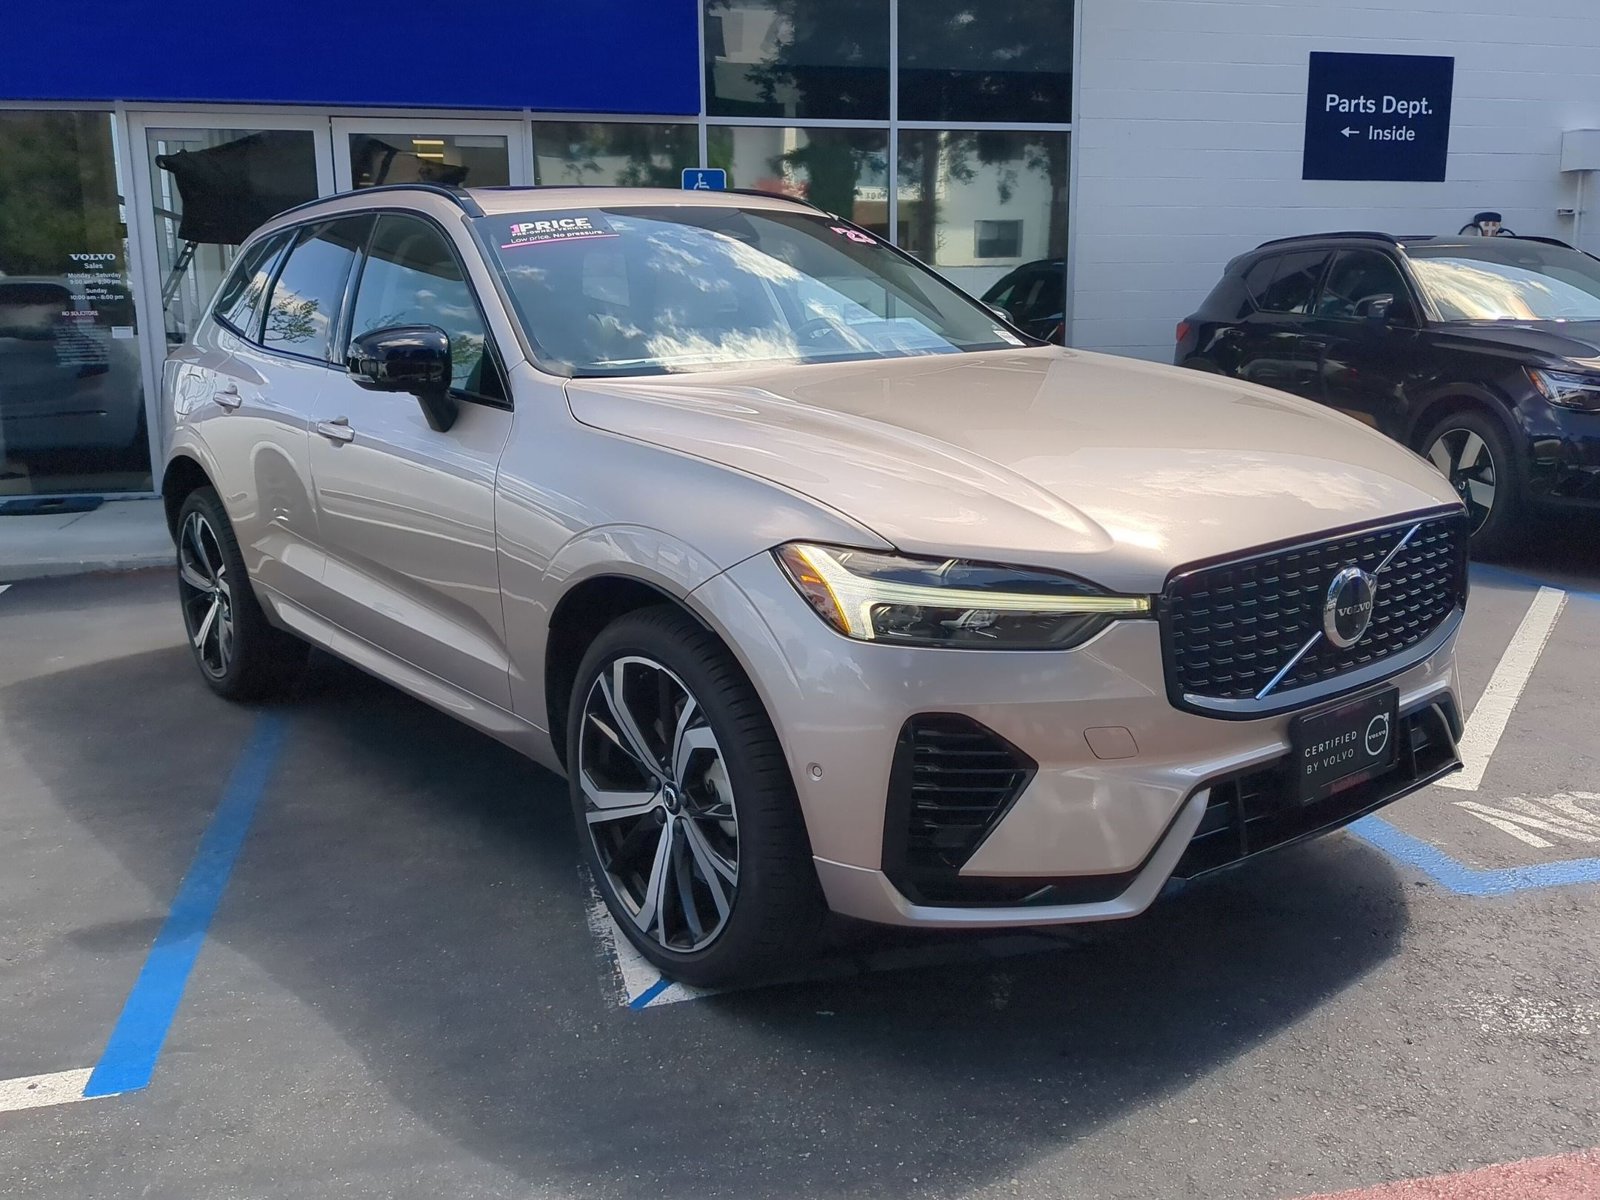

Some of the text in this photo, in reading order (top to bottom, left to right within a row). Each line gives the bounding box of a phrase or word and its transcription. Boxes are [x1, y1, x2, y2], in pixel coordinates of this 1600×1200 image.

[1325, 94, 1433, 118] Parts Dept.
[1368, 125, 1416, 141] Inside
[510, 217, 591, 234] 1PRICE
[512, 228, 556, 236] PRE-OWNED
[1337, 601, 1371, 616] VOLVO
[1368, 729, 1386, 740] VOLVO
[1304, 731, 1357, 758] CERTIFIED
[1306, 748, 1354, 775] BY VOLVO
